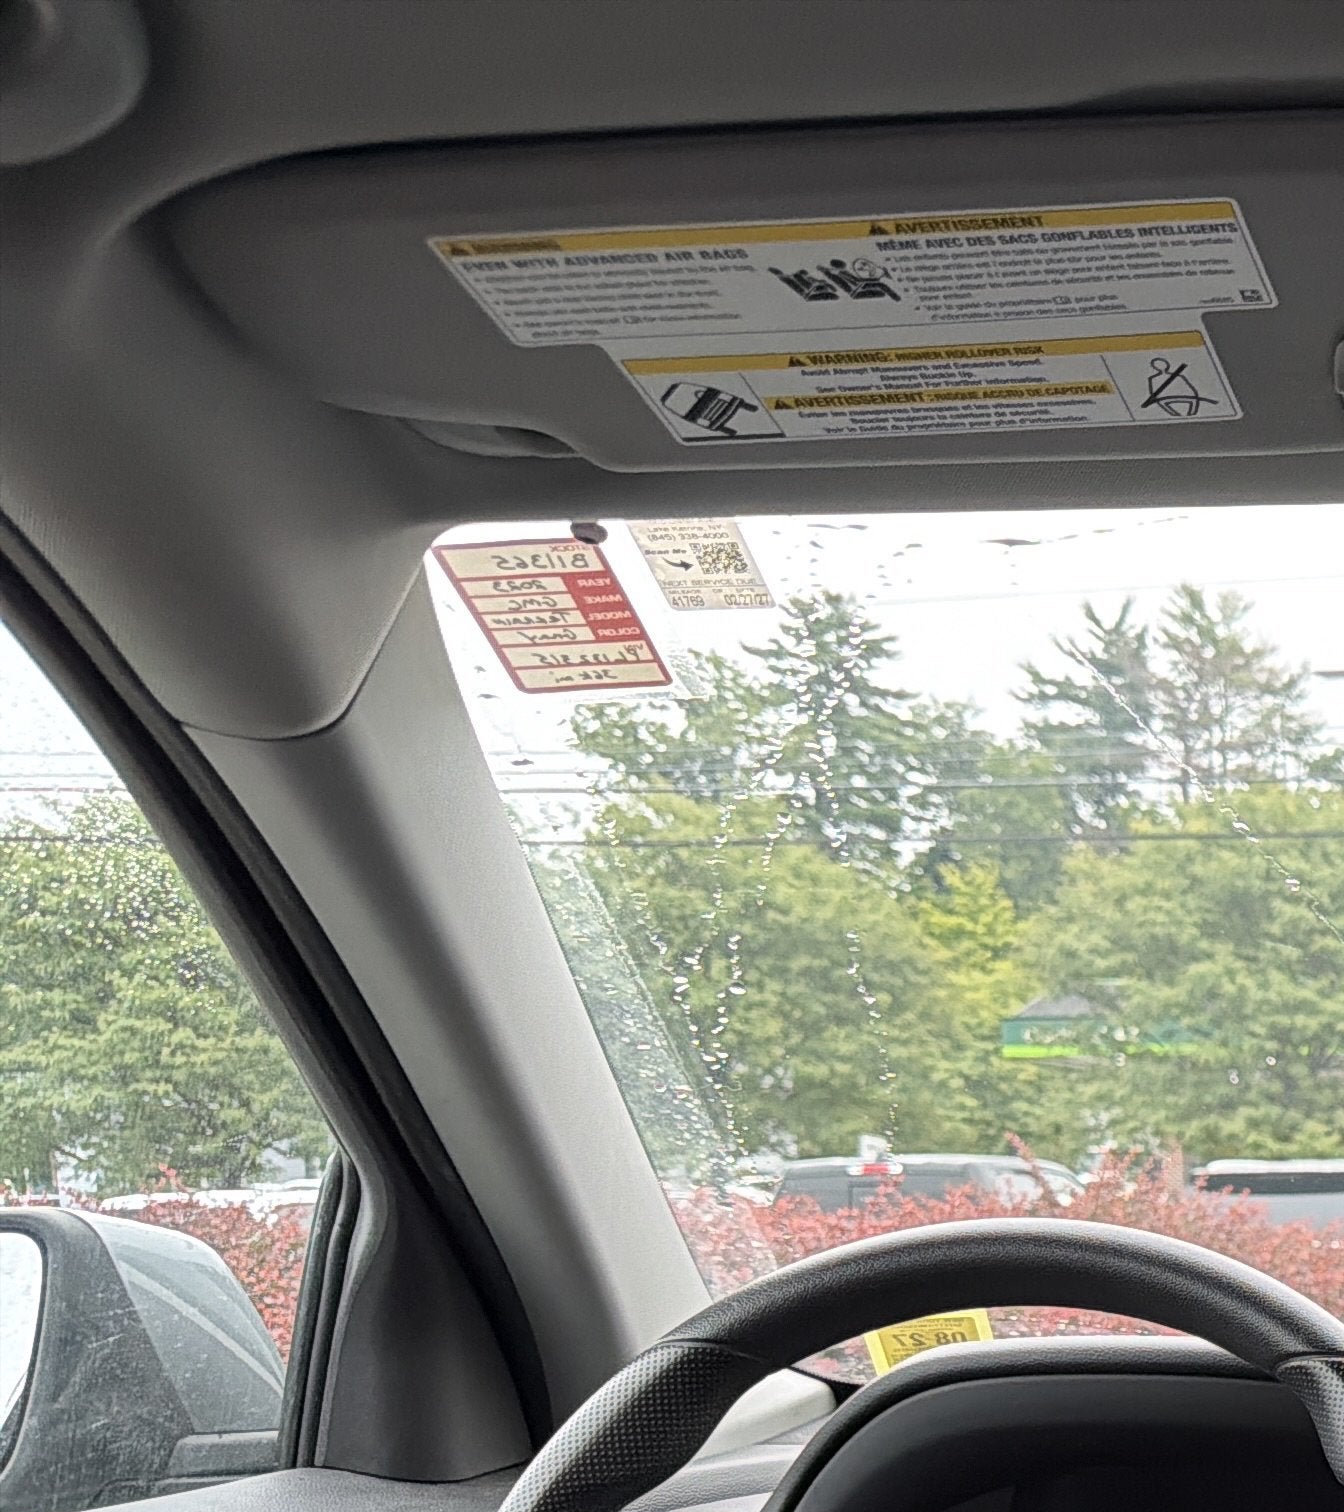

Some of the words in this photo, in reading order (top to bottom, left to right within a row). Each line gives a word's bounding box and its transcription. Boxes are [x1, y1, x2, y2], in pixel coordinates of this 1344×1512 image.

[894, 214, 1042, 234] AVERTISSEMENT
[925, 237, 962, 249] AVEC
[965, 235, 995, 247] DES
[997, 233, 1037, 245] SACS
[1040, 227, 1135, 243] GONFLABLES
[1136, 221, 1238, 237] INTELLIGENTS
[510, 257, 558, 268] WITH
[564, 252, 657, 266] ADVANCED
[664, 250, 694, 261] AIR
[698, 247, 748, 259] BAGS
[814, 352, 892, 365] WARNING:
[944, 347, 1017, 360] ROLLOVER
[1018, 346, 1044, 357] RISK
[794, 392, 921, 409] AVERTISSEMENT
[647, 533, 676, 542] (845)
